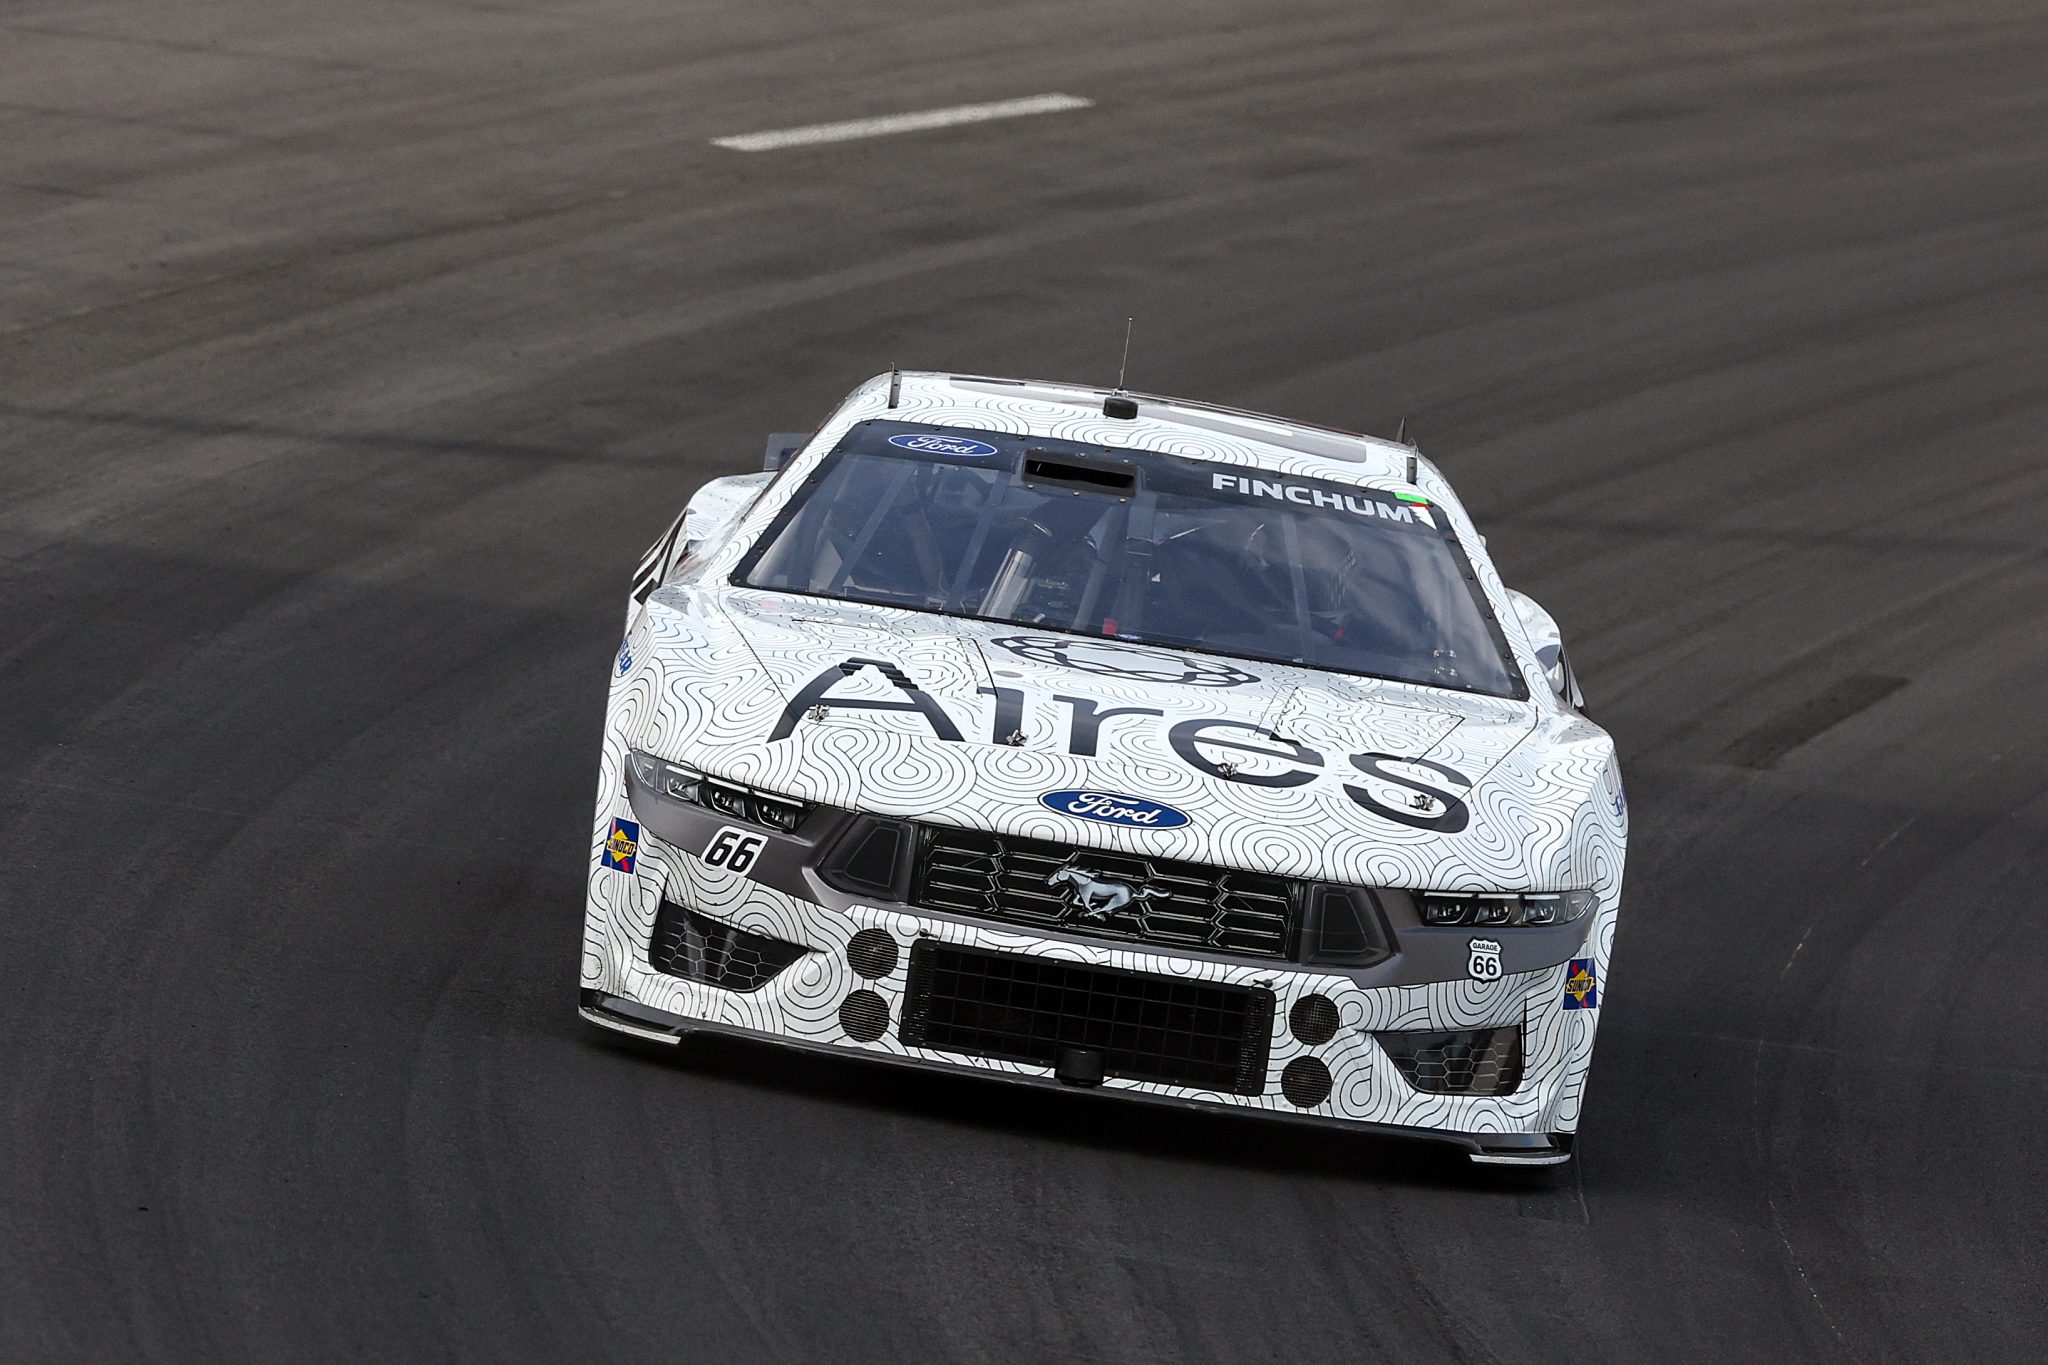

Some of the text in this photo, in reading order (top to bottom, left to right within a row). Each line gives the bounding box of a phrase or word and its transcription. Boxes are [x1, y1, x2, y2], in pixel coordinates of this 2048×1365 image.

[907, 436, 978, 454] Ford
[1212, 472, 1413, 524] FINCHUM
[767, 656, 1470, 833] Aires
[1067, 793, 1162, 824] Ford
[704, 831, 762, 873] 66
[1472, 942, 1498, 952] GARAGE
[1473, 955, 1497, 976] 66
